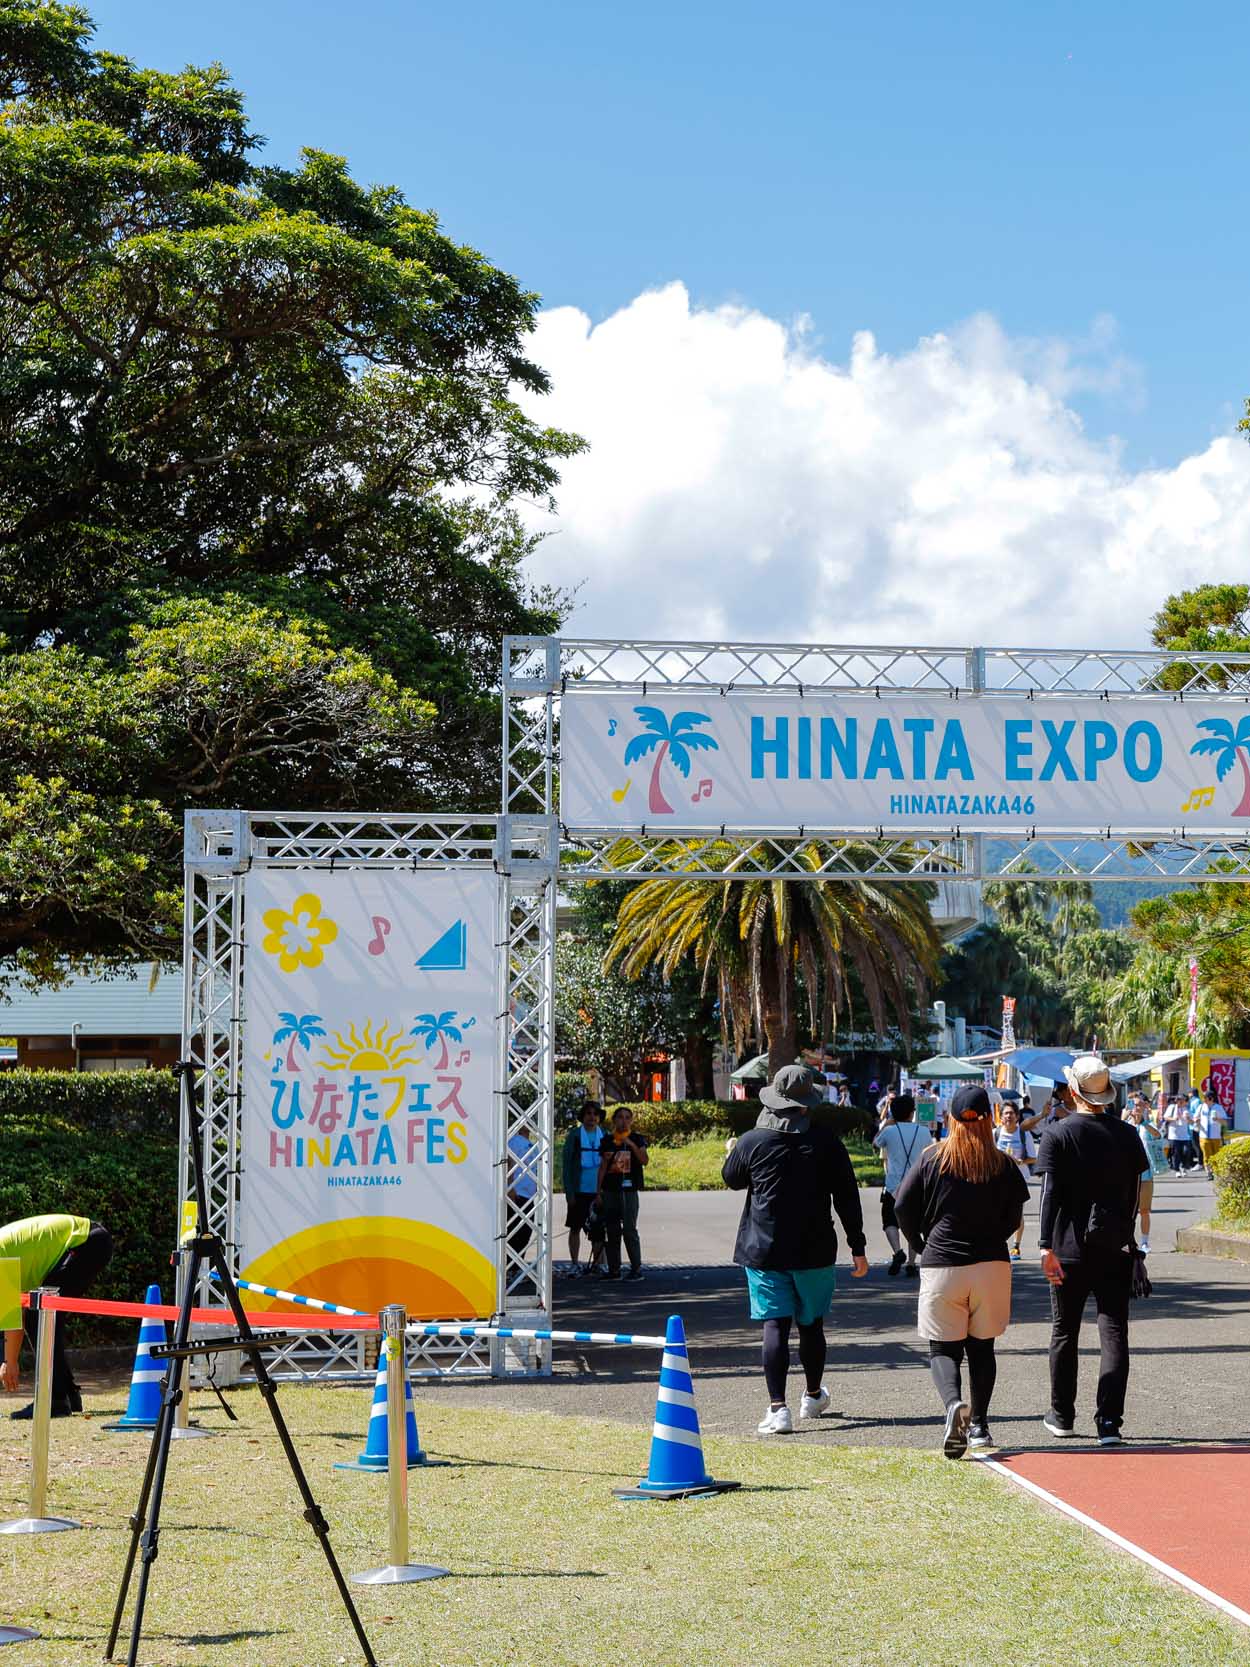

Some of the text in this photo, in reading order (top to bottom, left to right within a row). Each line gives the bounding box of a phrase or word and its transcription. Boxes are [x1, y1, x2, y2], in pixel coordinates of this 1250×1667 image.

[751, 716, 1163, 783] HINATA EXPO
[890, 794, 1035, 816] HINATAZAKA46
[270, 1075, 468, 1134] ひなたフェス
[270, 1118, 468, 1167] HINATA FES
[327, 1174, 402, 1188] HINATAZAKA46
